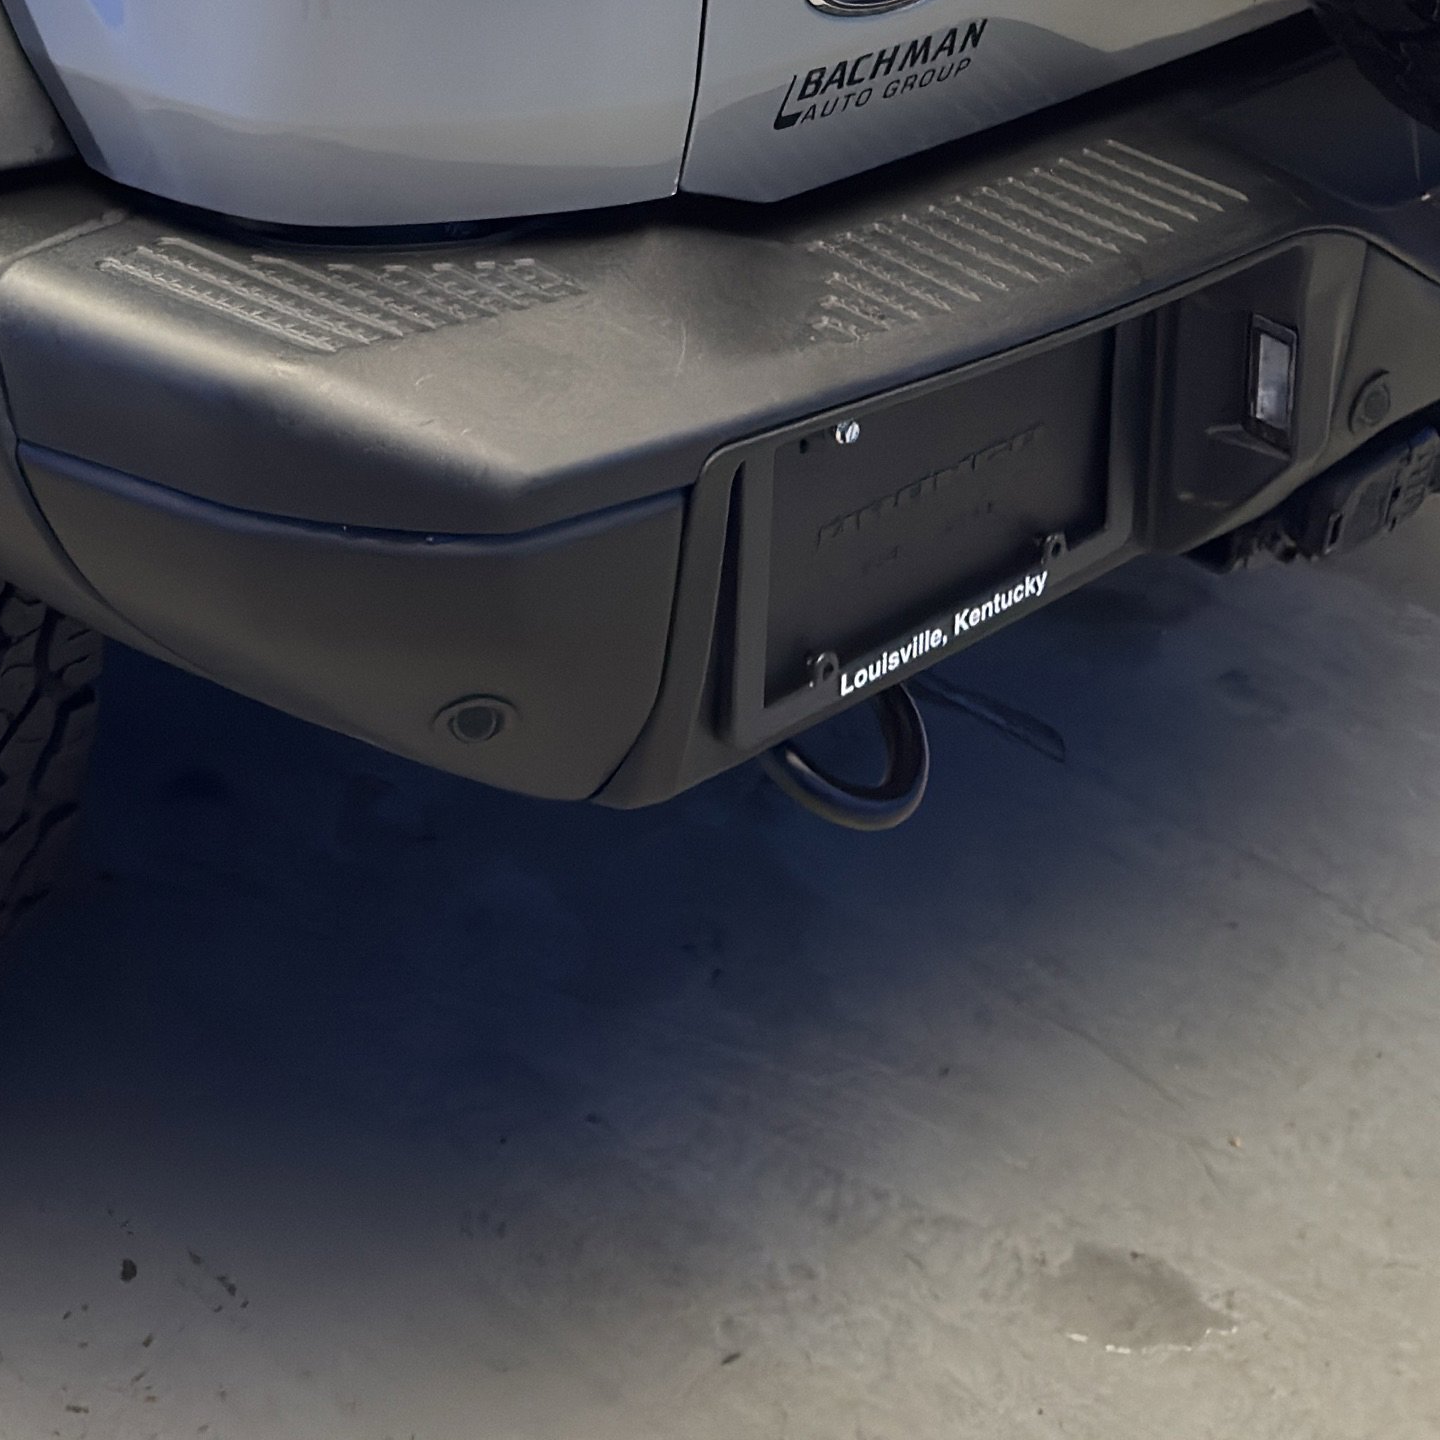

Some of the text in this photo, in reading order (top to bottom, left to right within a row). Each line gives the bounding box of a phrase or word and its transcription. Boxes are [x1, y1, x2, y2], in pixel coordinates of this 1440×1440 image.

[797, 18, 988, 101] BACHMAN
[800, 57, 972, 125] AUTO GROUP
[840, 571, 1048, 696] Louisville, Kentucky
